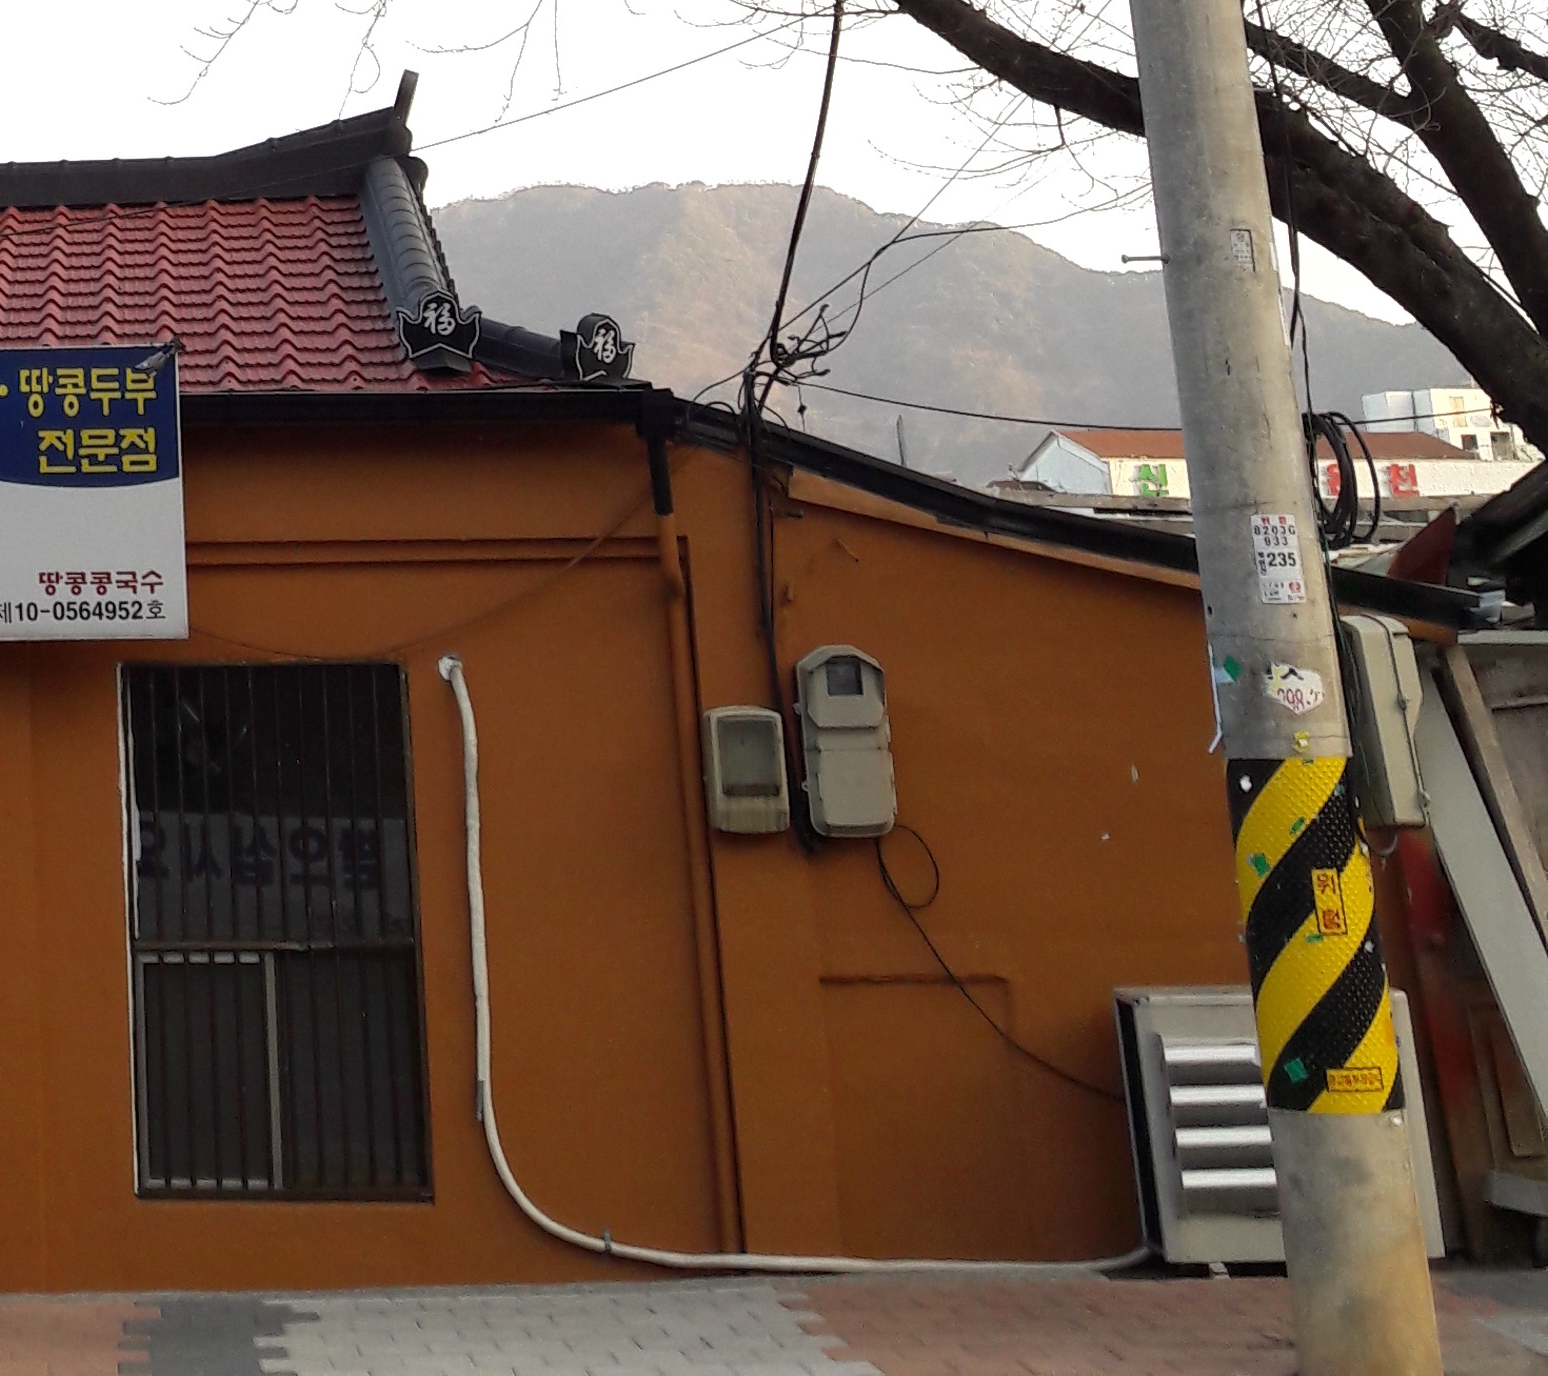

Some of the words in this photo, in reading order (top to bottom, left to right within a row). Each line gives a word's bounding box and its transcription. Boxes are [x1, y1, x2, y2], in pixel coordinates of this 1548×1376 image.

[18, 365, 158, 418] 땅콩두부
[37, 426, 158, 475] 전문점
[1266, 552, 1297, 567] 235
[37, 569, 164, 596] 땅콩콩국수
